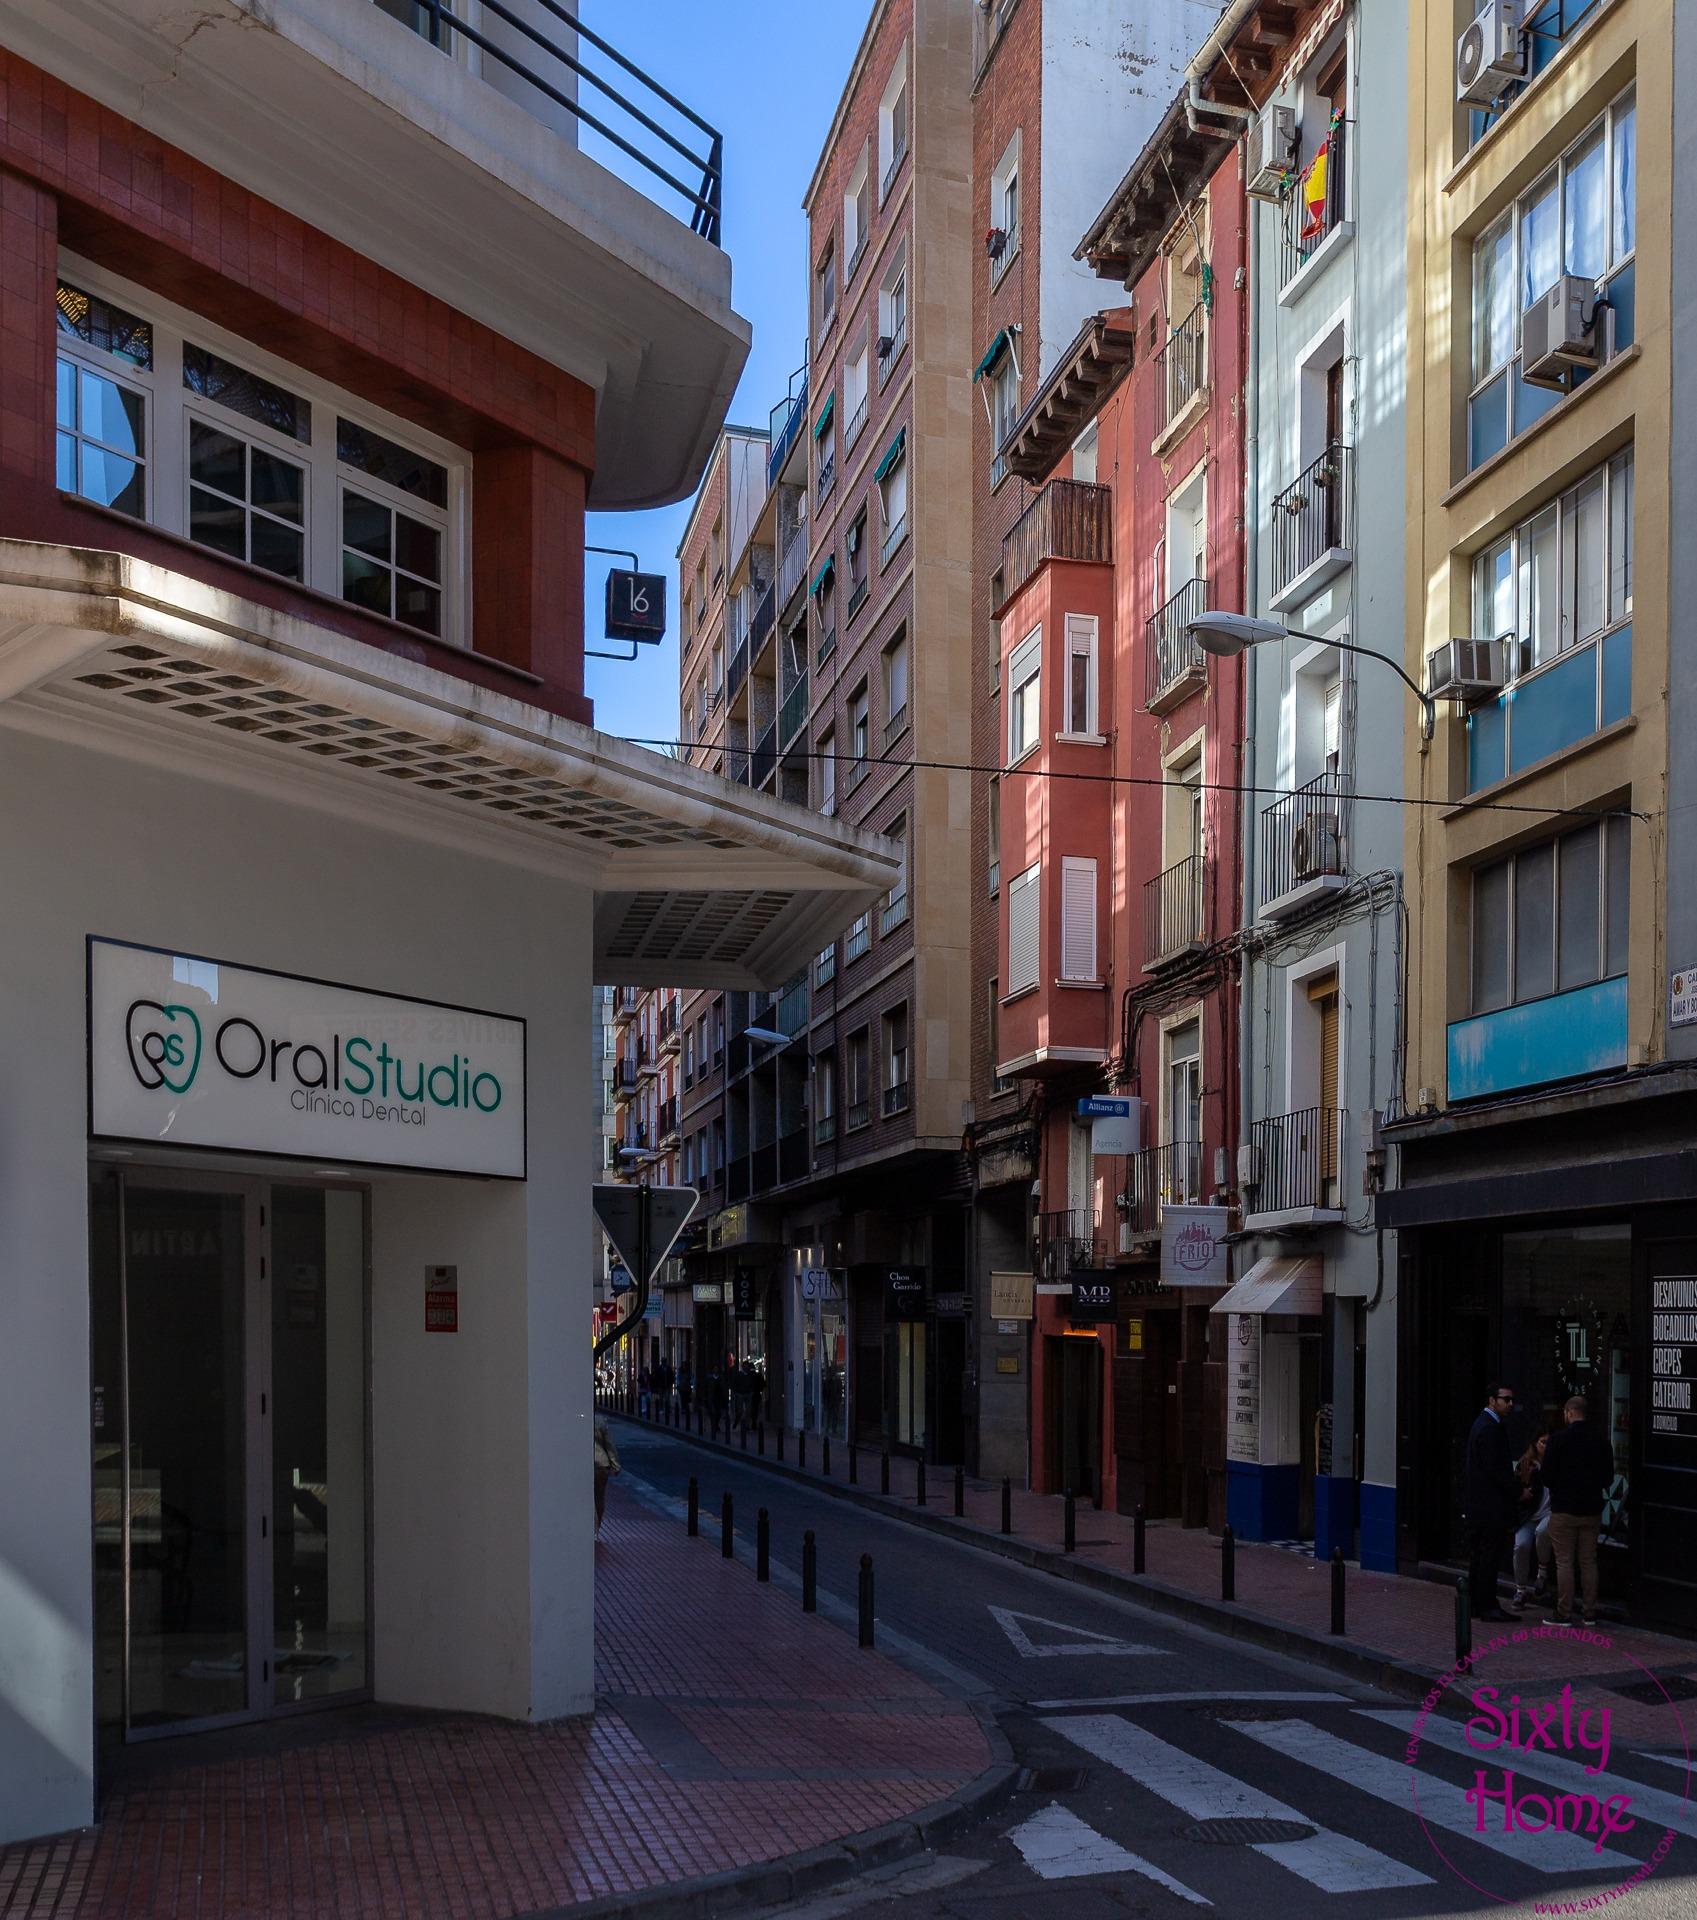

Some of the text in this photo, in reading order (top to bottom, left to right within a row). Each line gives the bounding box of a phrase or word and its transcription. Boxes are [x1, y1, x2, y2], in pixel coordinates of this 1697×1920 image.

[626, 576, 649, 613] 16
[215, 1017, 501, 1113] OralStudio
[290, 1089, 426, 1126] Clínica Dental
[1088, 1102, 1114, 1111] Allianz
[889, 1271, 910, 1281] Chon
[892, 1281, 922, 1291] Garrido
[427, 1293, 455, 1305] Alarma
[1078, 1285, 1111, 1297] MR
[1653, 1347, 1682, 1375] CREPES
[1653, 1380, 1691, 1409] CATERING
